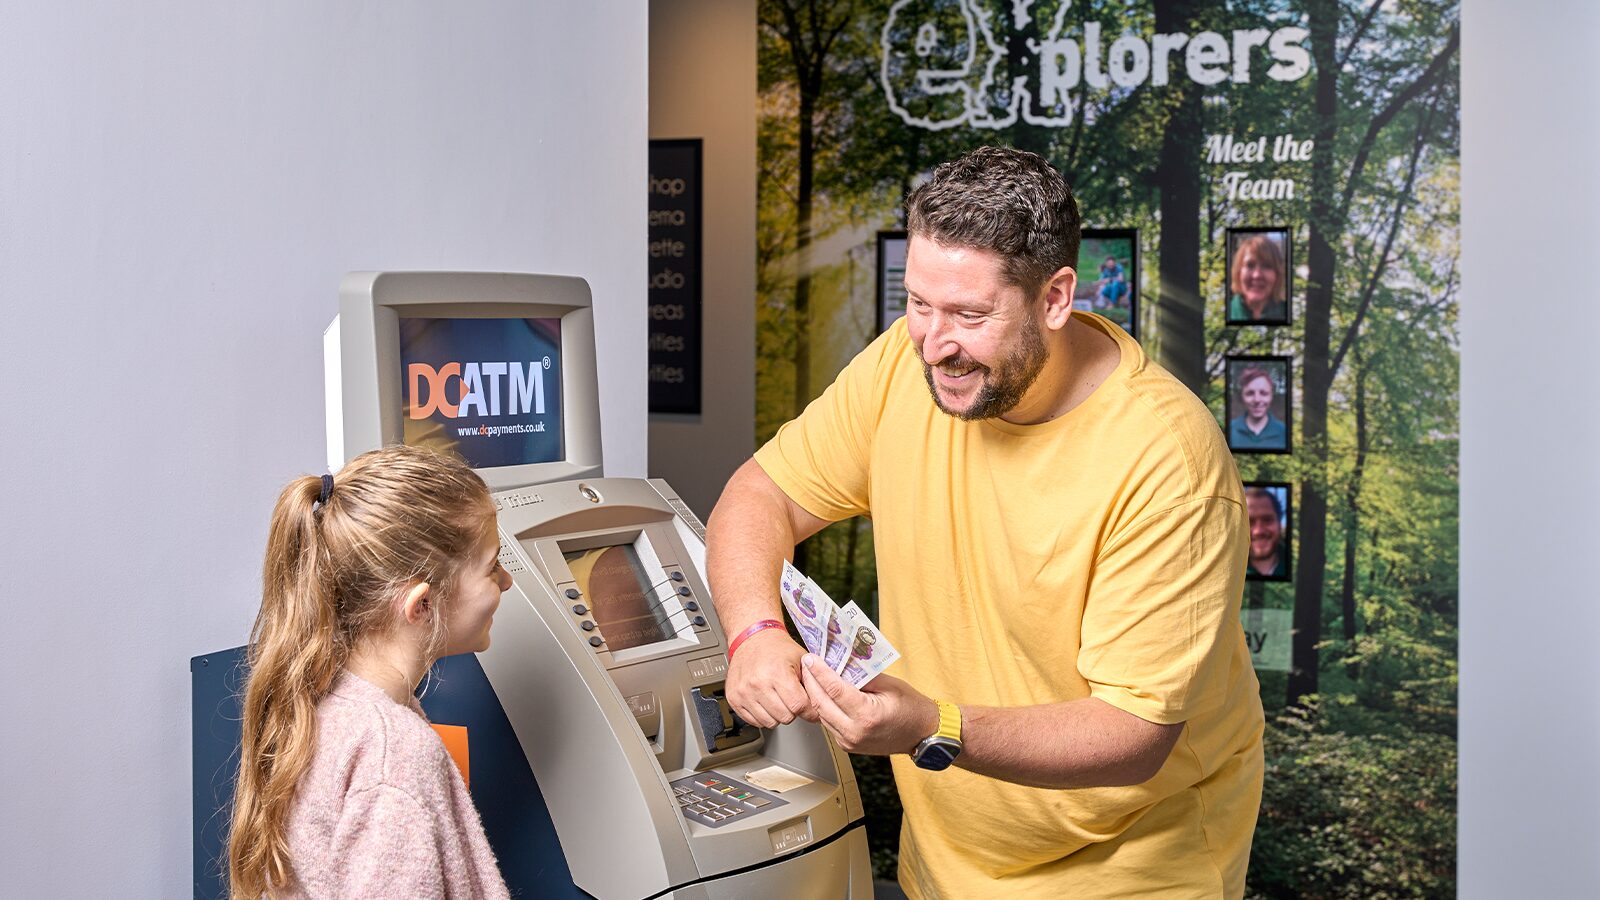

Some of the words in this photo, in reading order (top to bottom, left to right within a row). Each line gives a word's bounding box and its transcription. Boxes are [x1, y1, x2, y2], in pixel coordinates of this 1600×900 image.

[1205, 135, 1269, 164] Meet
[1271, 133, 1315, 163] the
[1221, 170, 1295, 201] Team
[457, 421, 546, 437] www.dcpayments.co.uk
